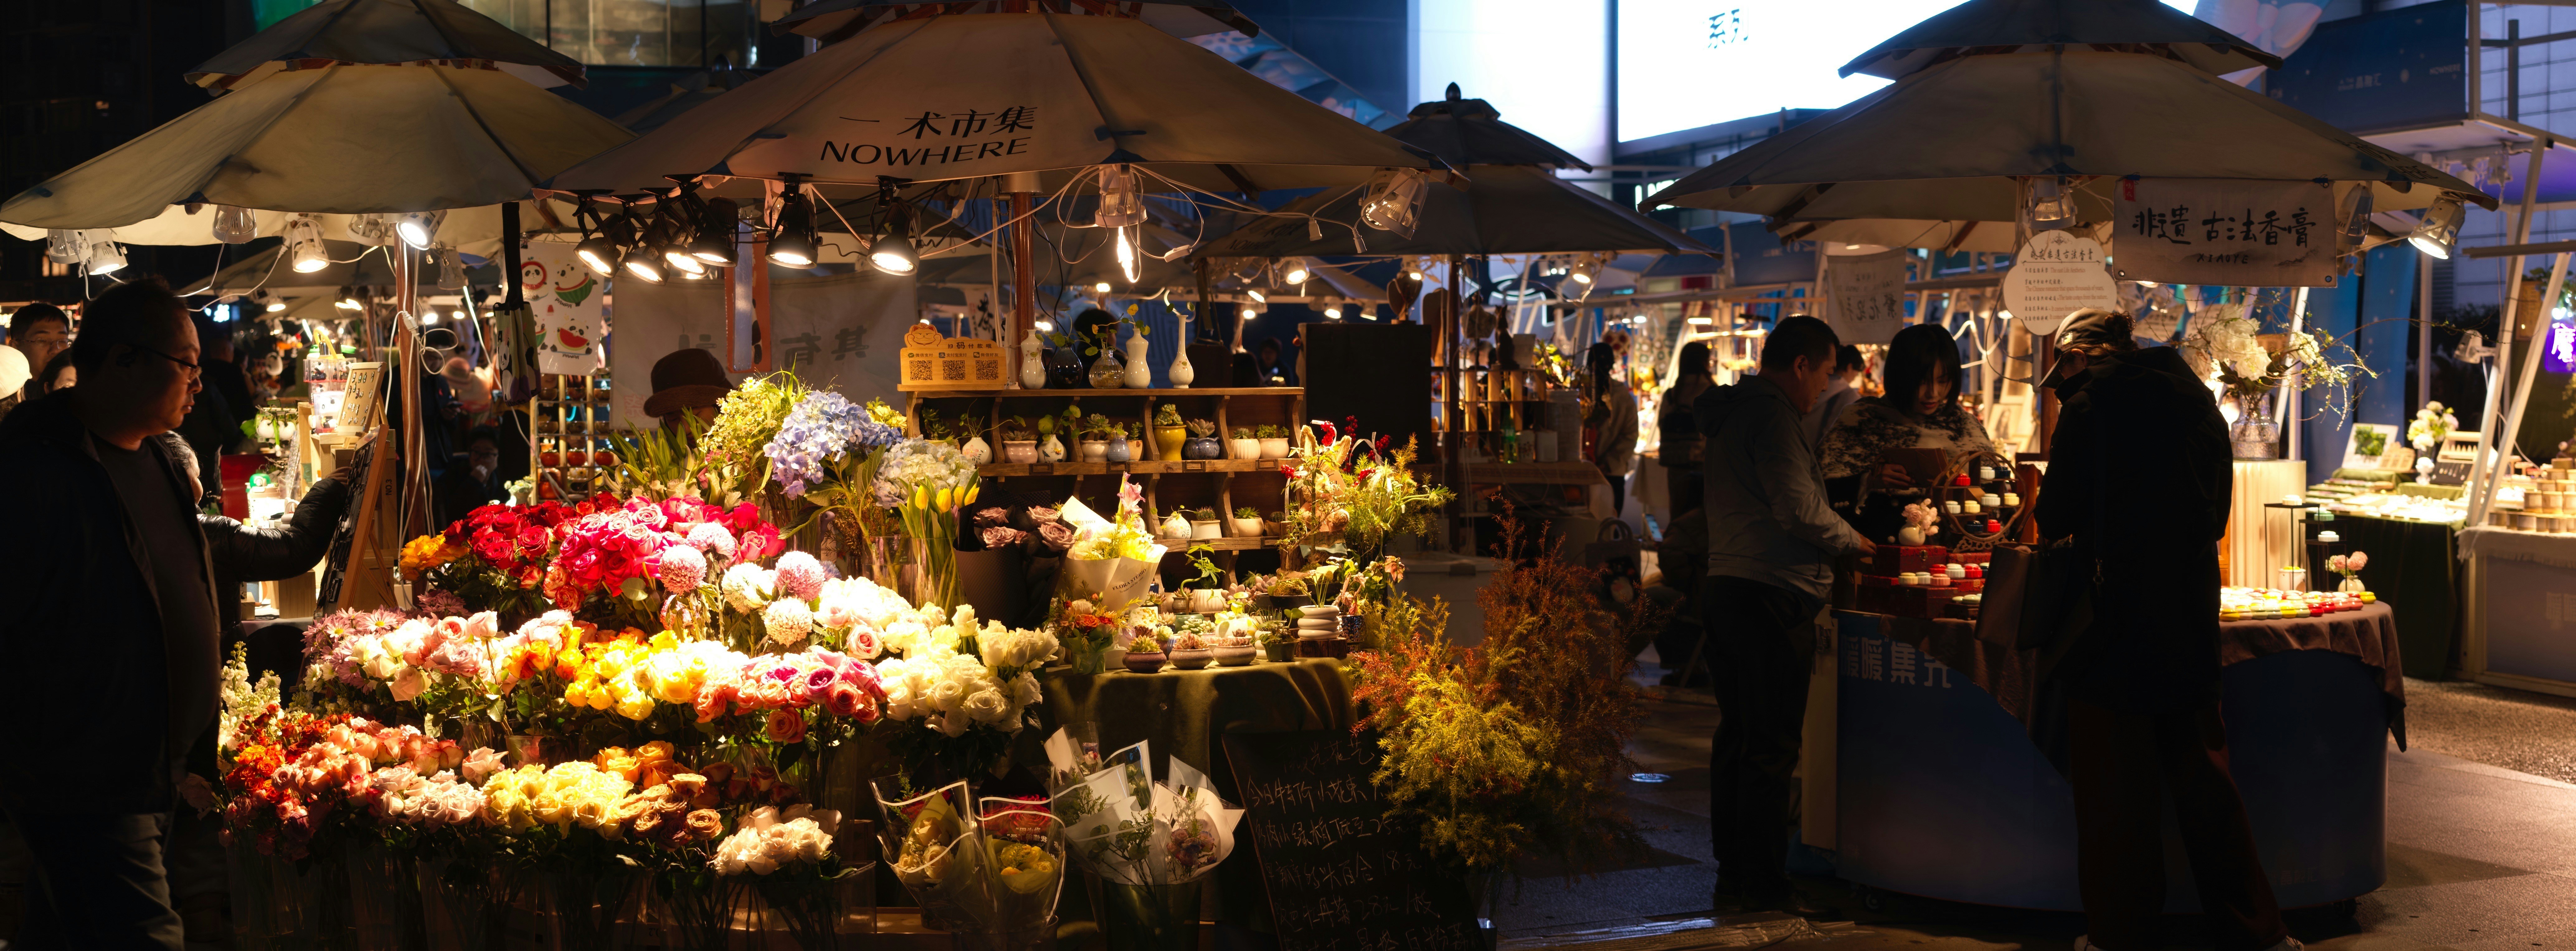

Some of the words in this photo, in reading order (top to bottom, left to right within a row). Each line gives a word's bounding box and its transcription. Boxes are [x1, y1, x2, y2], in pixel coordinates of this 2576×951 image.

[1708, 7, 1748, 49] 系列
[840, 106, 1038, 139] 一术市集
[821, 137, 1031, 166] NOWHERE
[2202, 207, 2317, 248] 古法香膏
[2196, 253, 2249, 265] XIAOYE
[1112, 581, 1130, 591] FLORA
[1130, 568, 1146, 583] STUDIO
